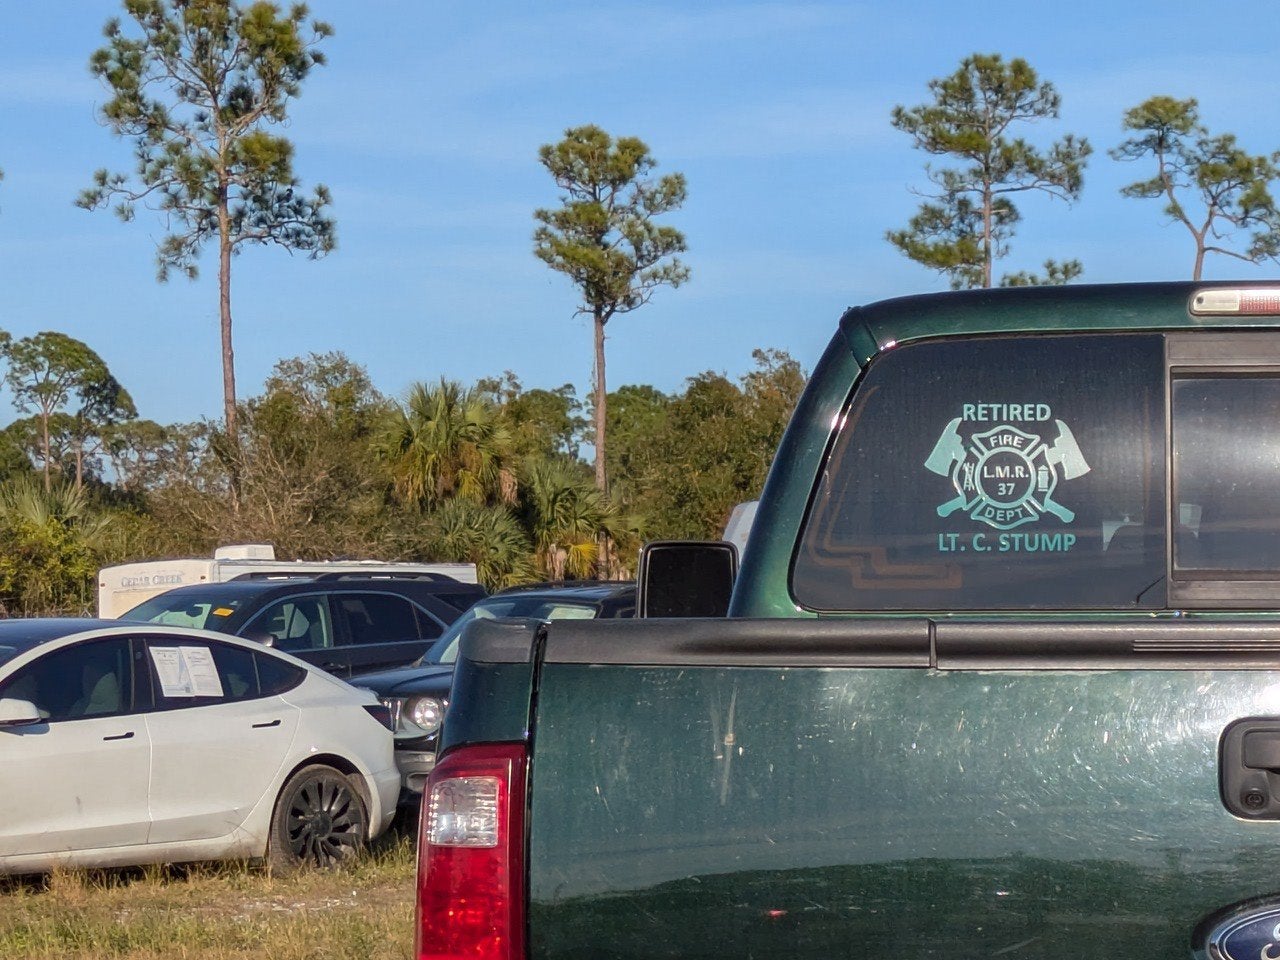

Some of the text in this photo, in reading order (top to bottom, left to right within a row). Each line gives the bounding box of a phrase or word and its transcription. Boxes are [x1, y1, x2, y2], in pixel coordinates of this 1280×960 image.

[963, 403, 1052, 422] RETIRED
[989, 434, 1024, 448] FIRE
[983, 465, 1029, 479] L.M.R.
[997, 482, 1016, 496] 37
[984, 506, 1024, 522] DEPT
[938, 533, 1077, 552] LT. C. STUMP
